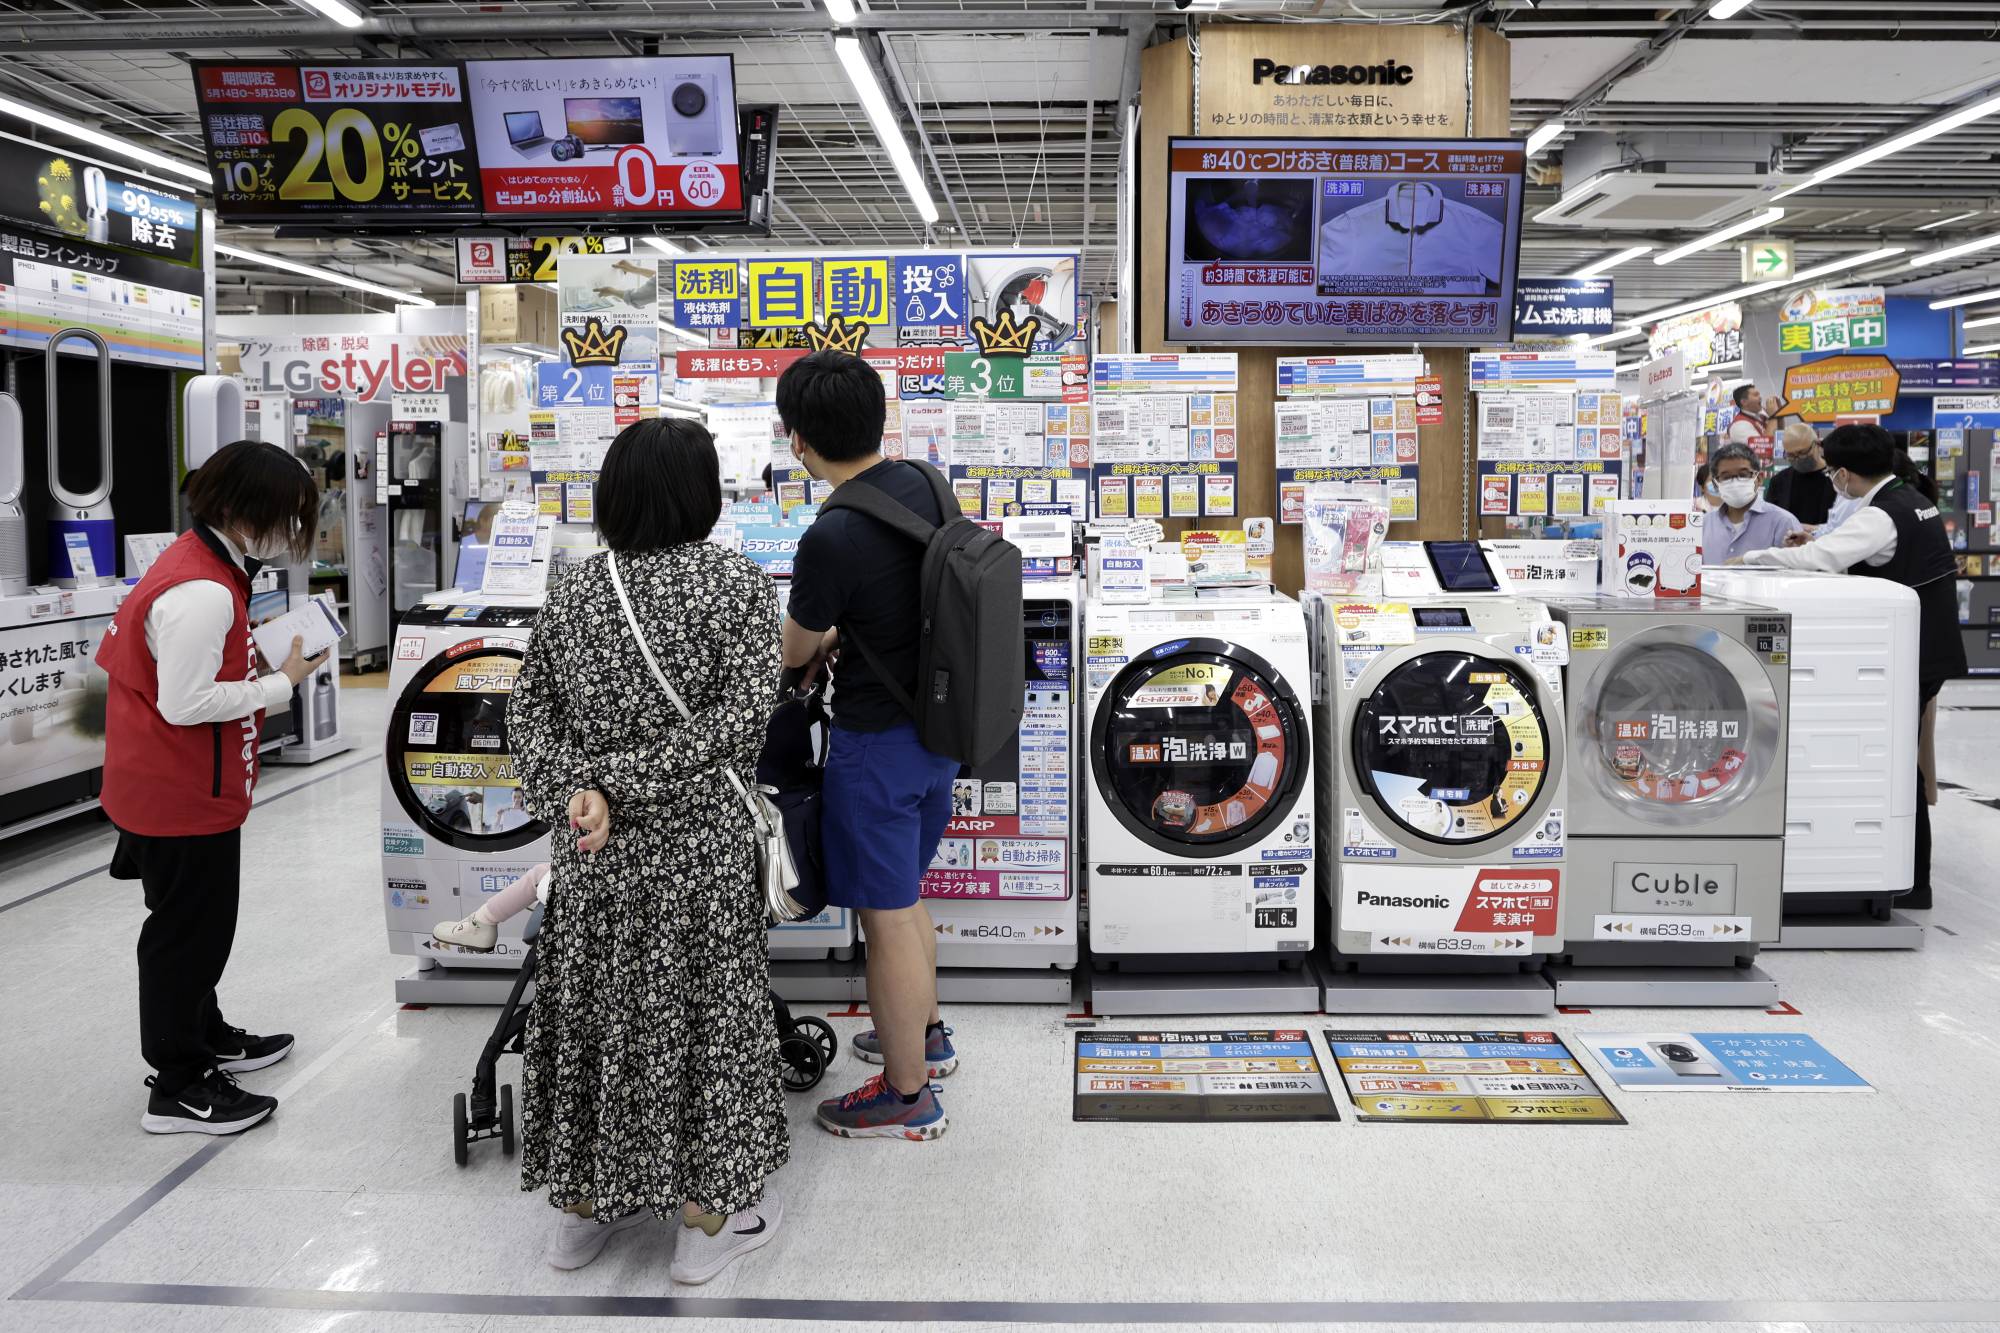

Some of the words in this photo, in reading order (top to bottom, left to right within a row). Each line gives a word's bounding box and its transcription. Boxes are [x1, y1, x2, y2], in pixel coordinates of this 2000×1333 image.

[222, 71, 277, 86] 期間限定
[1253, 58, 1413, 86] Panasonic
[335, 83, 455, 98] オリジナルモデル
[1273, 94, 1393, 108] あわただしい毎日に、
[209, 115, 264, 131] 当社指定
[1211, 112, 1453, 127] ゆとりの時間と、清潔な衣類という幸せを。
[213, 131, 239, 145] 商品
[272, 108, 385, 202] 20
[383, 122, 419, 158] %
[388, 158, 464, 178] ポイント
[217, 162, 259, 192] 10
[508, 175, 580, 185] はじめての方でも安心
[617, 149, 655, 206] 0
[657, 190, 674, 206] 円
[391, 182, 473, 201] サービス
[496, 186, 601, 205] ビックの分割払い
[687, 180, 712, 200] 60
[1326, 182, 1363, 196] 洗浄前
[1467, 184, 1502, 196] 洗浄後
[122, 190, 184, 226] 99.95%
[131, 216, 177, 250] 除去
[1, 234, 119, 273] 製品ラインナップ
[680, 269, 733, 294] 洗剤
[903, 265, 933, 294] 投
[1205, 267, 1312, 283] 約3時間で洗濯可能に!
[758, 267, 804, 320] 自
[830, 267, 883, 318] 動
[684, 302, 730, 313] 液体洗剤
[930, 292, 959, 319] 入
[690, 314, 725, 325] 柔軟剤
[1201, 302, 1498, 325] あきらめていた黄ばみを落とす!
[1782, 320, 1882, 350] 実演中
[302, 337, 369, 350] 除菌・脱臭
[263, 361, 312, 393] LG
[320, 344, 452, 403] styler
[948, 358, 1015, 394] 第3位
[541, 367, 605, 402] 第2位
[1966, 397, 1990, 409] Best
[967, 467, 1072, 479] お得なキャンペーン情報
[1112, 464, 1219, 475] お得なキャンペーン情報
[1295, 468, 1401, 480] お得なキャンペーン情報
[1495, 463, 1604, 473] お得なキャンペーン情報
[498, 537, 530, 545] 自動投入
[1106, 560, 1140, 568] 自動投入
[1089, 638, 1123, 648] 日本製
[1572, 631, 1607, 643] 日本製
[1185, 667, 1214, 679] No.1
[456, 674, 515, 691] 風アイロ
[414, 721, 434, 733] 除菌
[1379, 715, 1457, 734] スマホで
[1466, 719, 1489, 731] 洗濯
[1618, 723, 1646, 737] 温水
[1388, 737, 1488, 745] スマホ予約で毎日できたてお洗濯
[1131, 746, 1159, 761] 温水
[1512, 762, 1538, 771] 外出中
[945, 820, 996, 831] HARP
[1002, 849, 1062, 863] 自動お掃除
[1003, 882, 1062, 892] AI標準コース
[1490, 881, 1542, 891] 試してみよう!
[1631, 872, 1719, 895] Cuble
[1357, 891, 1450, 909] Panasonic
[1476, 896, 1529, 910] スマホで
[1534, 898, 1551, 908] 洗濯
[1655, 899, 1694, 907] キューブル
[1258, 914, 1276, 925] 11kg
[1281, 913, 1294, 925] 6kg
[1492, 912, 1536, 926] 実演中
[1093, 1080, 1124, 1091] 温水
[1256, 1081, 1313, 1090] 自動投入
[1361, 1080, 1396, 1090] 温水
[1507, 1105, 1565, 1115] スマホで
